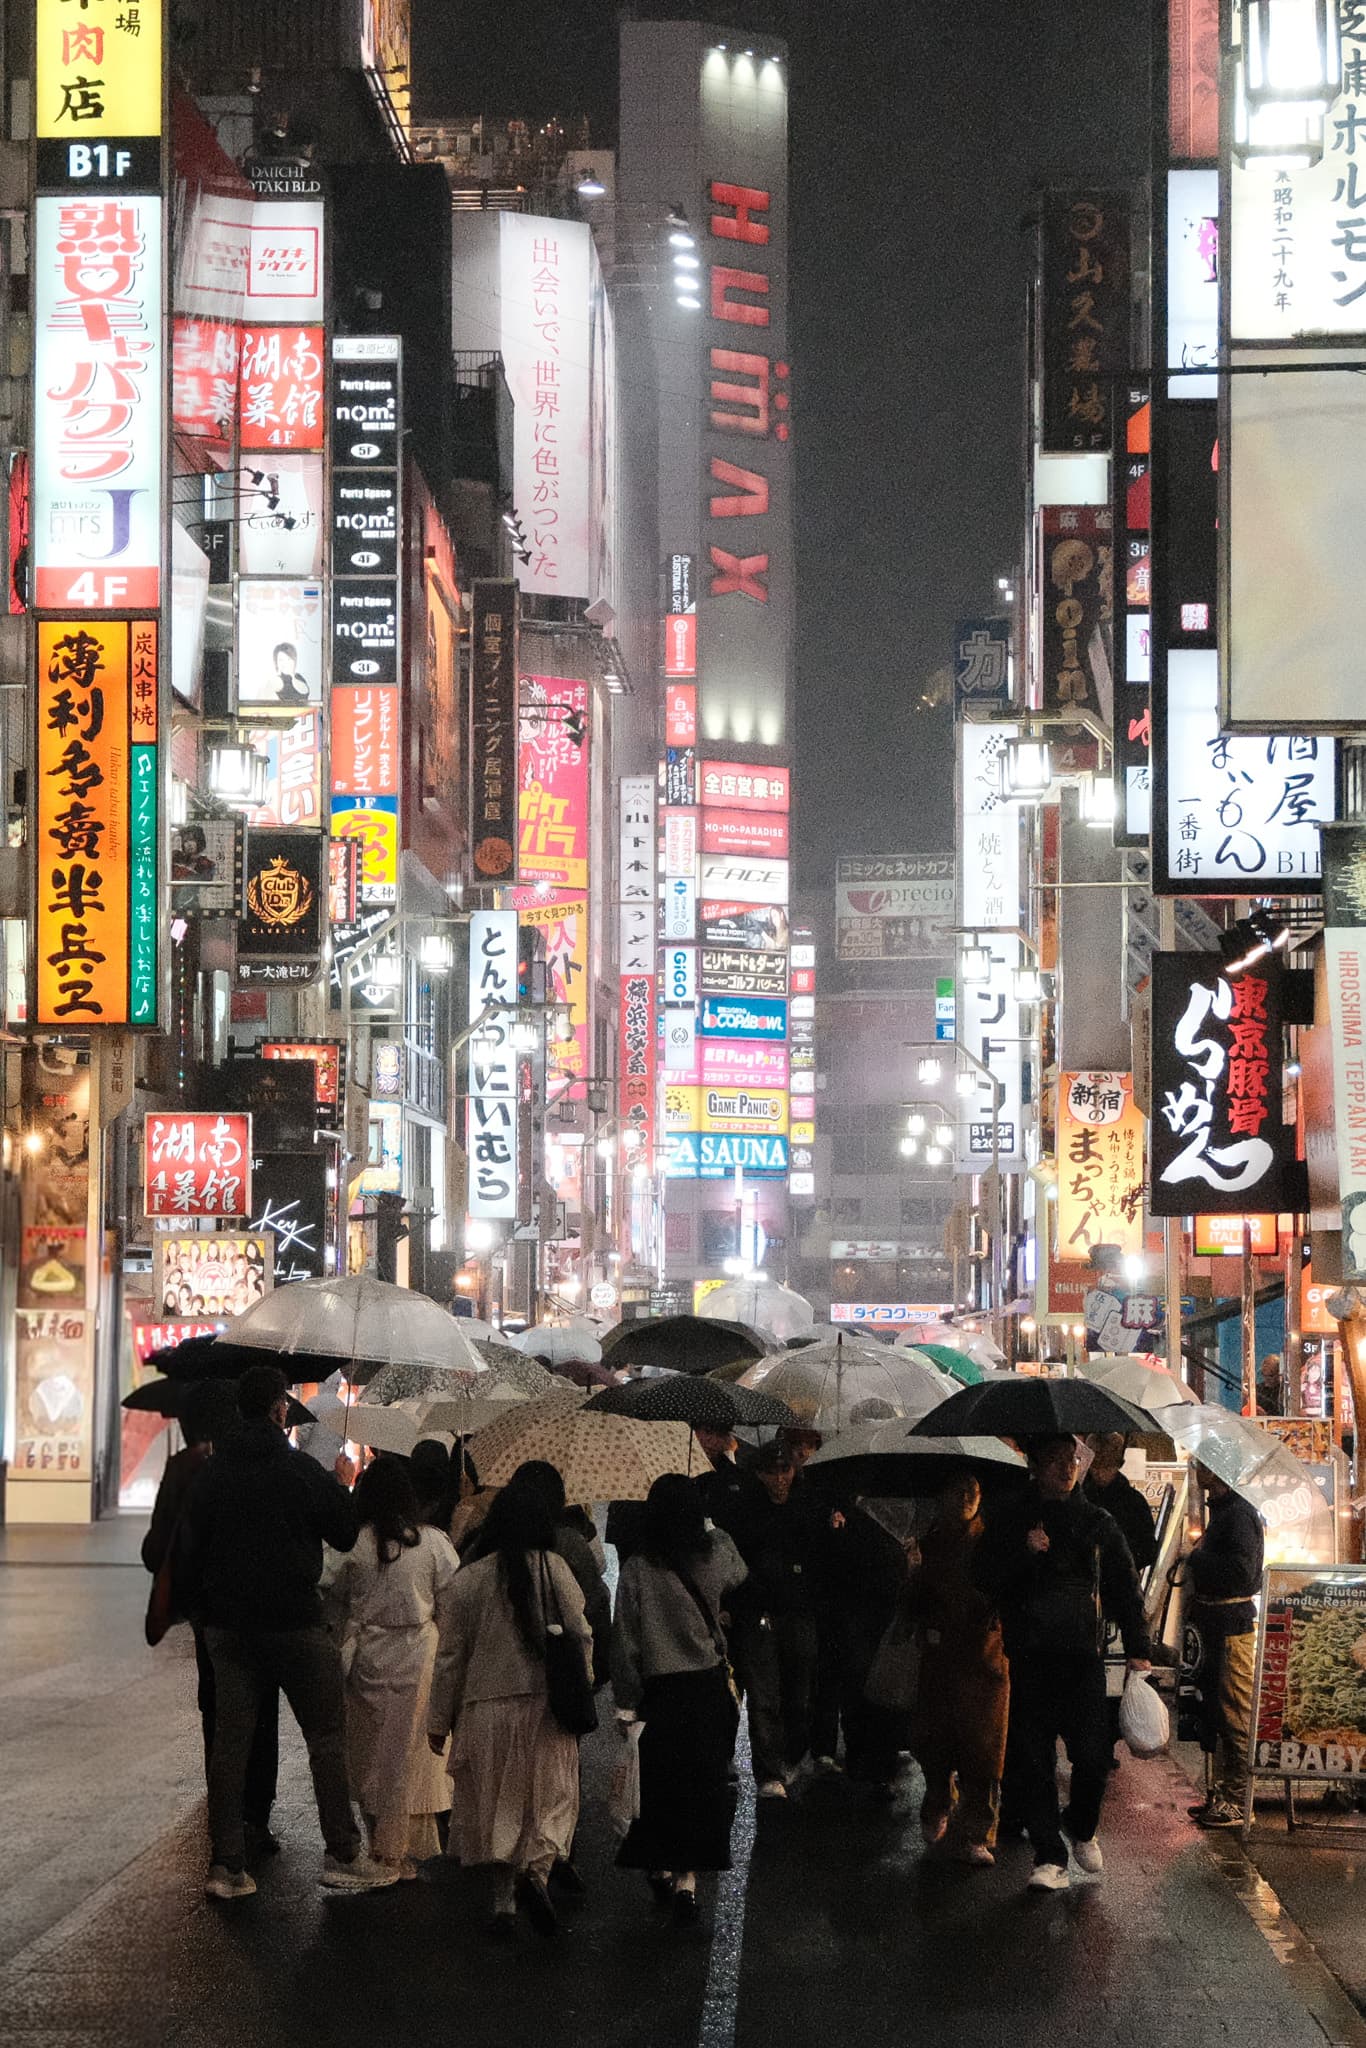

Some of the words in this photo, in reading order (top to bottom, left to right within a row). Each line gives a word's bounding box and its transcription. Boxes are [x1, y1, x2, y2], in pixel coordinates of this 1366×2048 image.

[115, 0, 141, 37] 場
[54, 0, 105, 123] 肉店
[68, 144, 132, 178] B1F
[292, 180, 321, 192] BLD
[242, 331, 321, 381] 湖南
[531, 237, 560, 579] 出会いで、世界に色がついた
[267, 429, 296, 445] 4F
[67, 571, 128, 607] 4F
[133, 632, 154, 726] 炭火串焼
[353, 690, 373, 791] リフレッシュ
[379, 690, 390, 750] レンタルルーム
[379, 753, 390, 787] ホステル
[704, 773, 785, 801] 全店営業中
[354, 797, 376, 809] 1F
[136, 780, 153, 898] エノケン流れる
[977, 832, 1002, 891] 焼とん
[1175, 797, 1203, 876] 一番街
[364, 886, 394, 899] 天神
[704, 866, 785, 884] FACE
[525, 904, 584, 923] 今すぐ見つかる
[135, 903, 153, 994] 楽しいお店
[240, 965, 313, 979] 第一大滝ビル
[673, 951, 687, 998] GiGO
[1338, 951, 1360, 1048] HIROSHIMA
[625, 979, 650, 1076] 横浜家系
[474, 927, 512, 1202] とんかつにいむら
[1227, 974, 1270, 1137] 東京豚骨
[151, 1117, 242, 1169] 湖南
[701, 1135, 787, 1168] SAUNA
[1068, 1127, 1107, 1245] まっちゃん
[1257, 1606, 1293, 1742] TEPPAN
[1280, 1741, 1366, 1773] BABY
